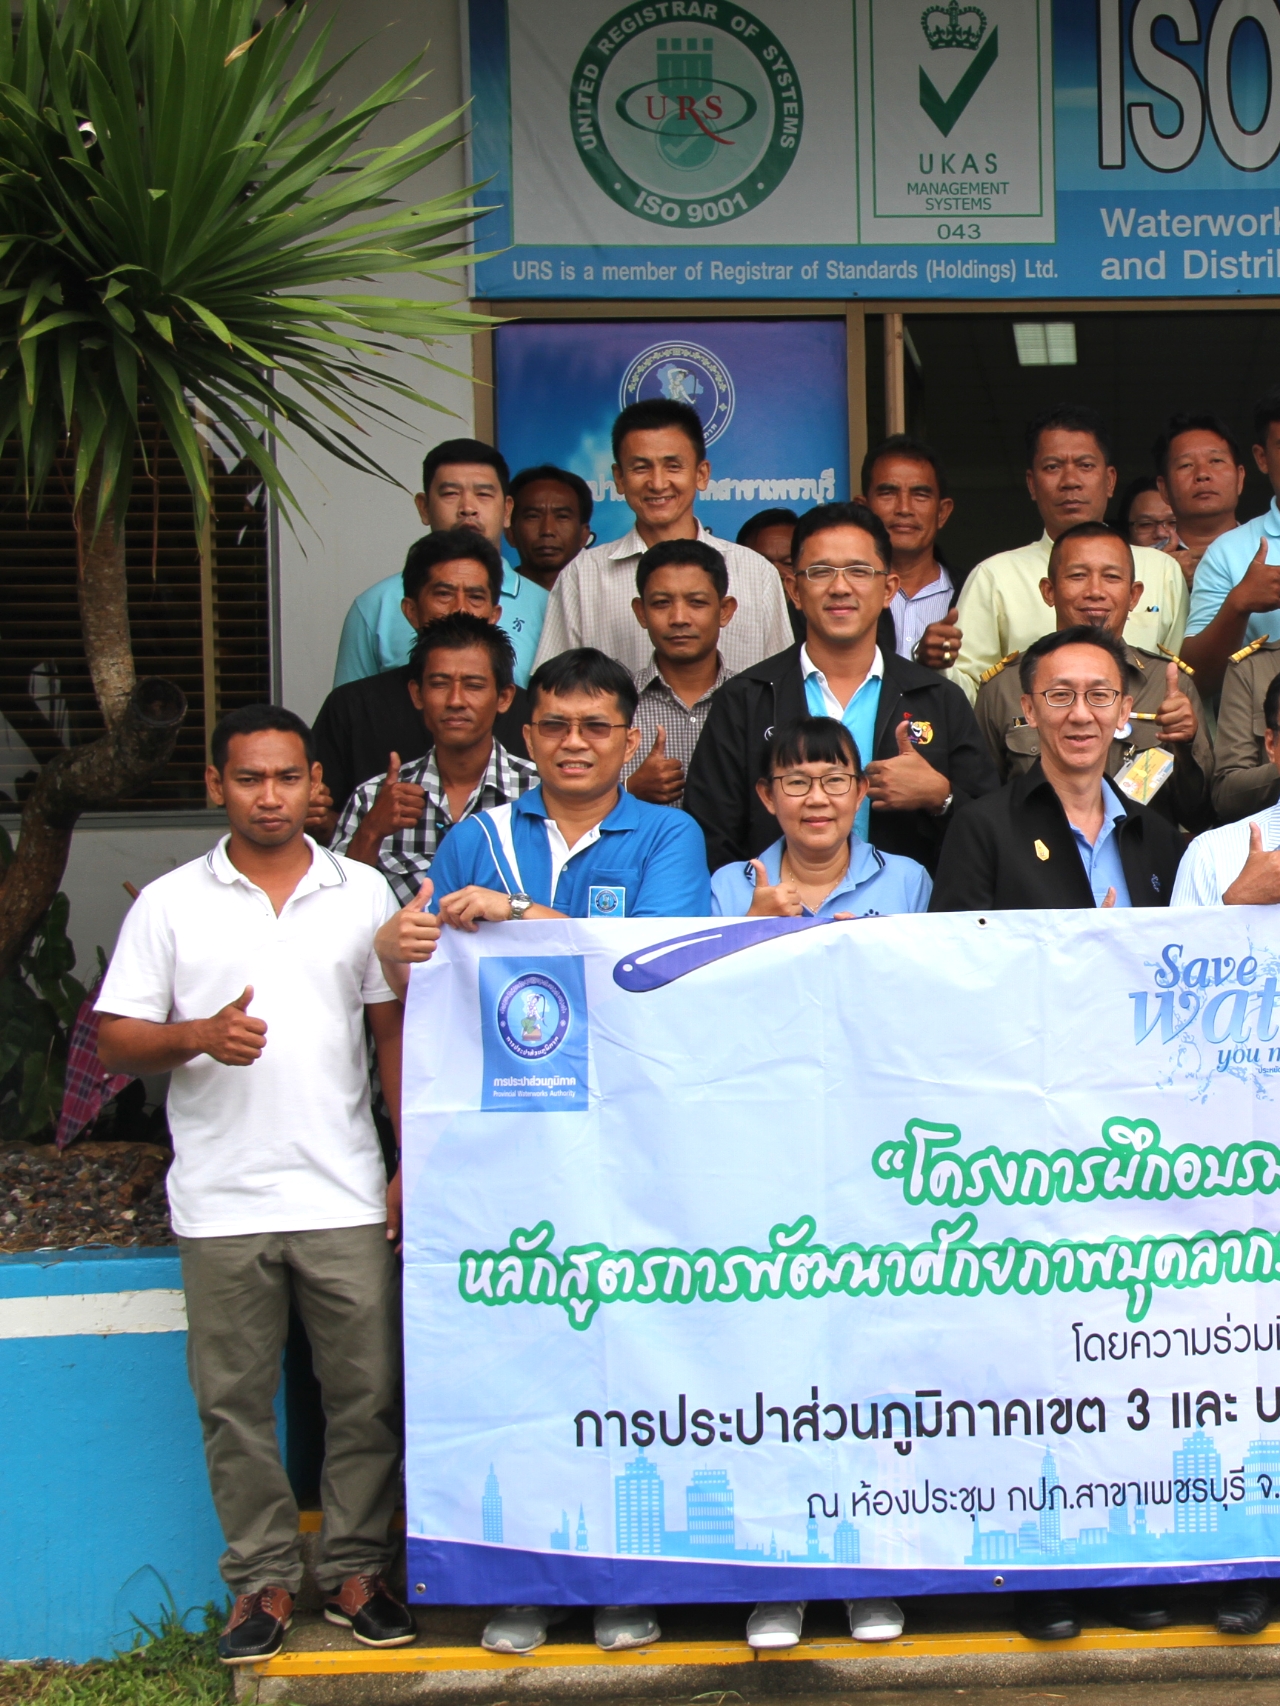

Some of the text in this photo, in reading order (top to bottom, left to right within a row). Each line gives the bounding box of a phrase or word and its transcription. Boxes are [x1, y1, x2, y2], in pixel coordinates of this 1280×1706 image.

[577, 1, 798, 150] UNITED REGISTRAR OF SYSTEMS
[919, 152, 998, 175] UKAS
[907, 181, 1010, 196] MANAGEMENT
[634, 191, 749, 223] ISO 9001
[925, 197, 992, 211] SYSTEMS
[937, 223, 981, 240] 043
[513, 259, 1058, 285] URS is a member of Registrar of Standards (Holdings) Ltd.
[1101, 250, 1166, 281] and
[1154, 944, 1258, 988] Save
[1216, 1045, 1259, 1072] you
[493, 1075, 577, 1089] การประปาส่วนภูมิภาค
[550, 1089, 576, 1099] Authority
[573, 1386, 1107, 1456] การประปาส่วนภูมิภาคเขต
[1127, 1388, 1150, 1431] 3
[1172, 1389, 1238, 1429] และ
[807, 1492, 839, 1519] ณ
[852, 1479, 996, 1521] ห้องประชุม
[1008, 1466, 1246, 1512] กปภ.สาขาเพชรบุรี
